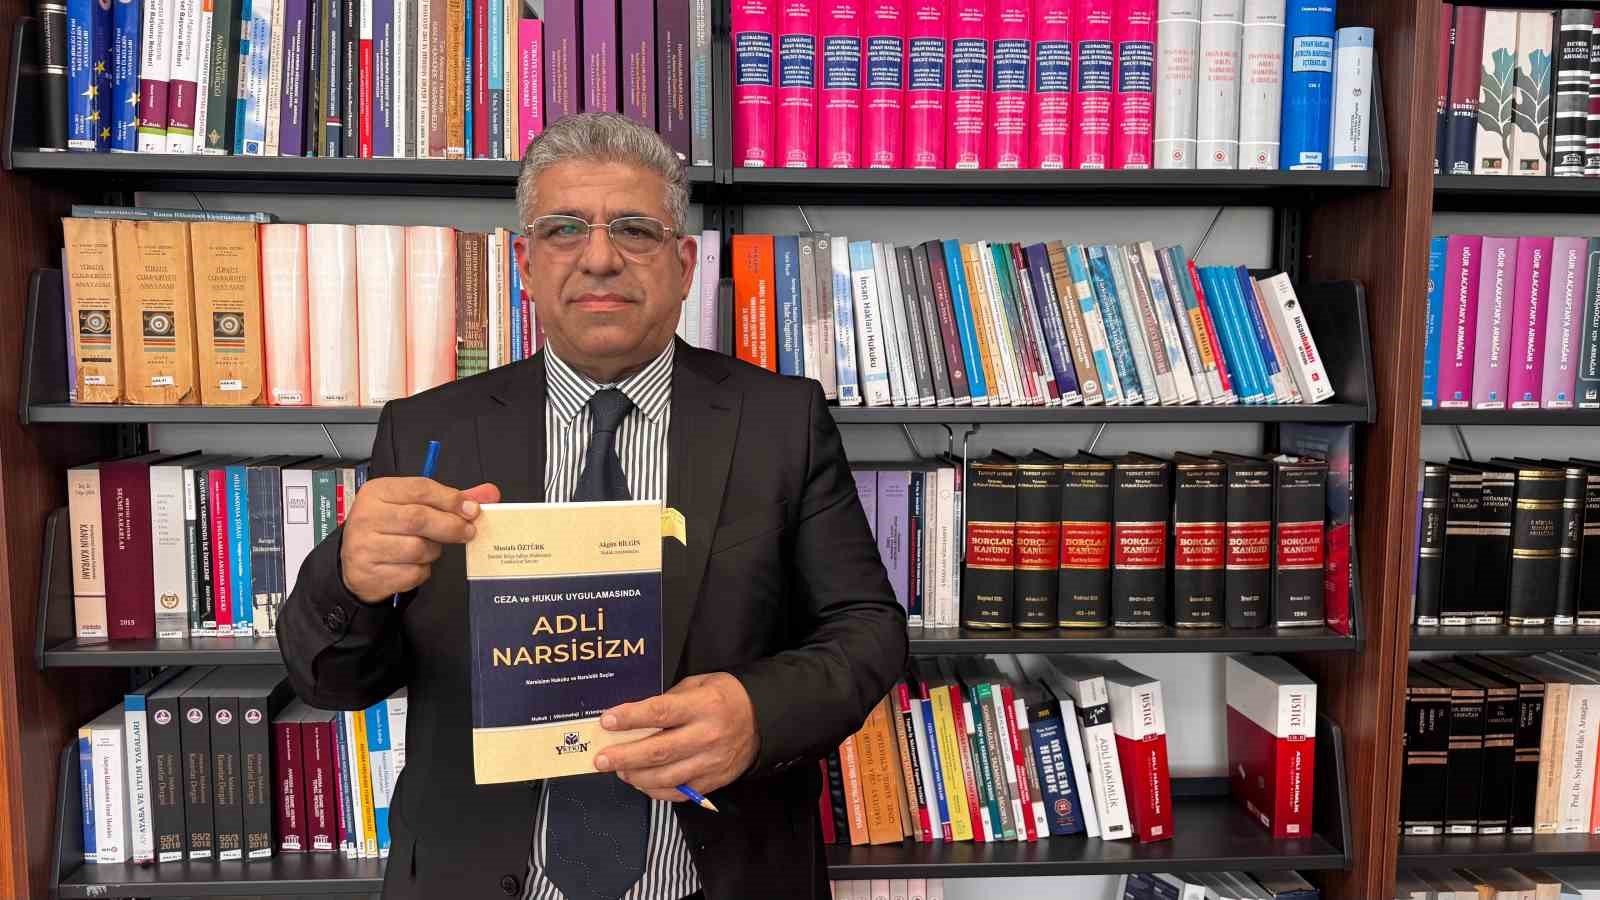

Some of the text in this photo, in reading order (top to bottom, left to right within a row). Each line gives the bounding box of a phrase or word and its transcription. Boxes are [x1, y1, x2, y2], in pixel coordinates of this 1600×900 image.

[528, 129, 535, 140] 5
[1462, 247, 1471, 266] UĞUR
[1496, 248, 1505, 267] UĞUR
[1533, 250, 1542, 269] UĞUR
[1568, 250, 1577, 269] UĞUR
[860, 276, 877, 368] İnsan Hakları Hukuku
[1456, 325, 1465, 360] ARMAĞAN
[1490, 326, 1500, 360] ARMAĞAN
[1526, 328, 1535, 362] ARMAĞAN
[1560, 328, 1570, 362] ARMAĞAN
[80, 524, 90, 580] KANUN KAVRAMI
[517, 543, 545, 551] ÖZTÜRK
[494, 595, 518, 604] CEZA
[532, 594, 563, 602] HUKUK
[566, 590, 641, 601] UYGULAMASINDA
[532, 608, 604, 635] ADLİ
[493, 636, 645, 666] NARSİSİZM
[1140, 693, 1152, 727] JUSTICE
[1290, 694, 1303, 727] JUSTICE
[133, 720, 142, 763] YASALARI
[1039, 744, 1057, 794] HUKUK
[1050, 739, 1071, 795] MEDENİ
[1099, 738, 1119, 808] ADLİ HAKİMLİK
[1574, 750, 1584, 779] Seyfullah
[138, 794, 144, 804] VE
[1570, 792, 1579, 808] Prof.
